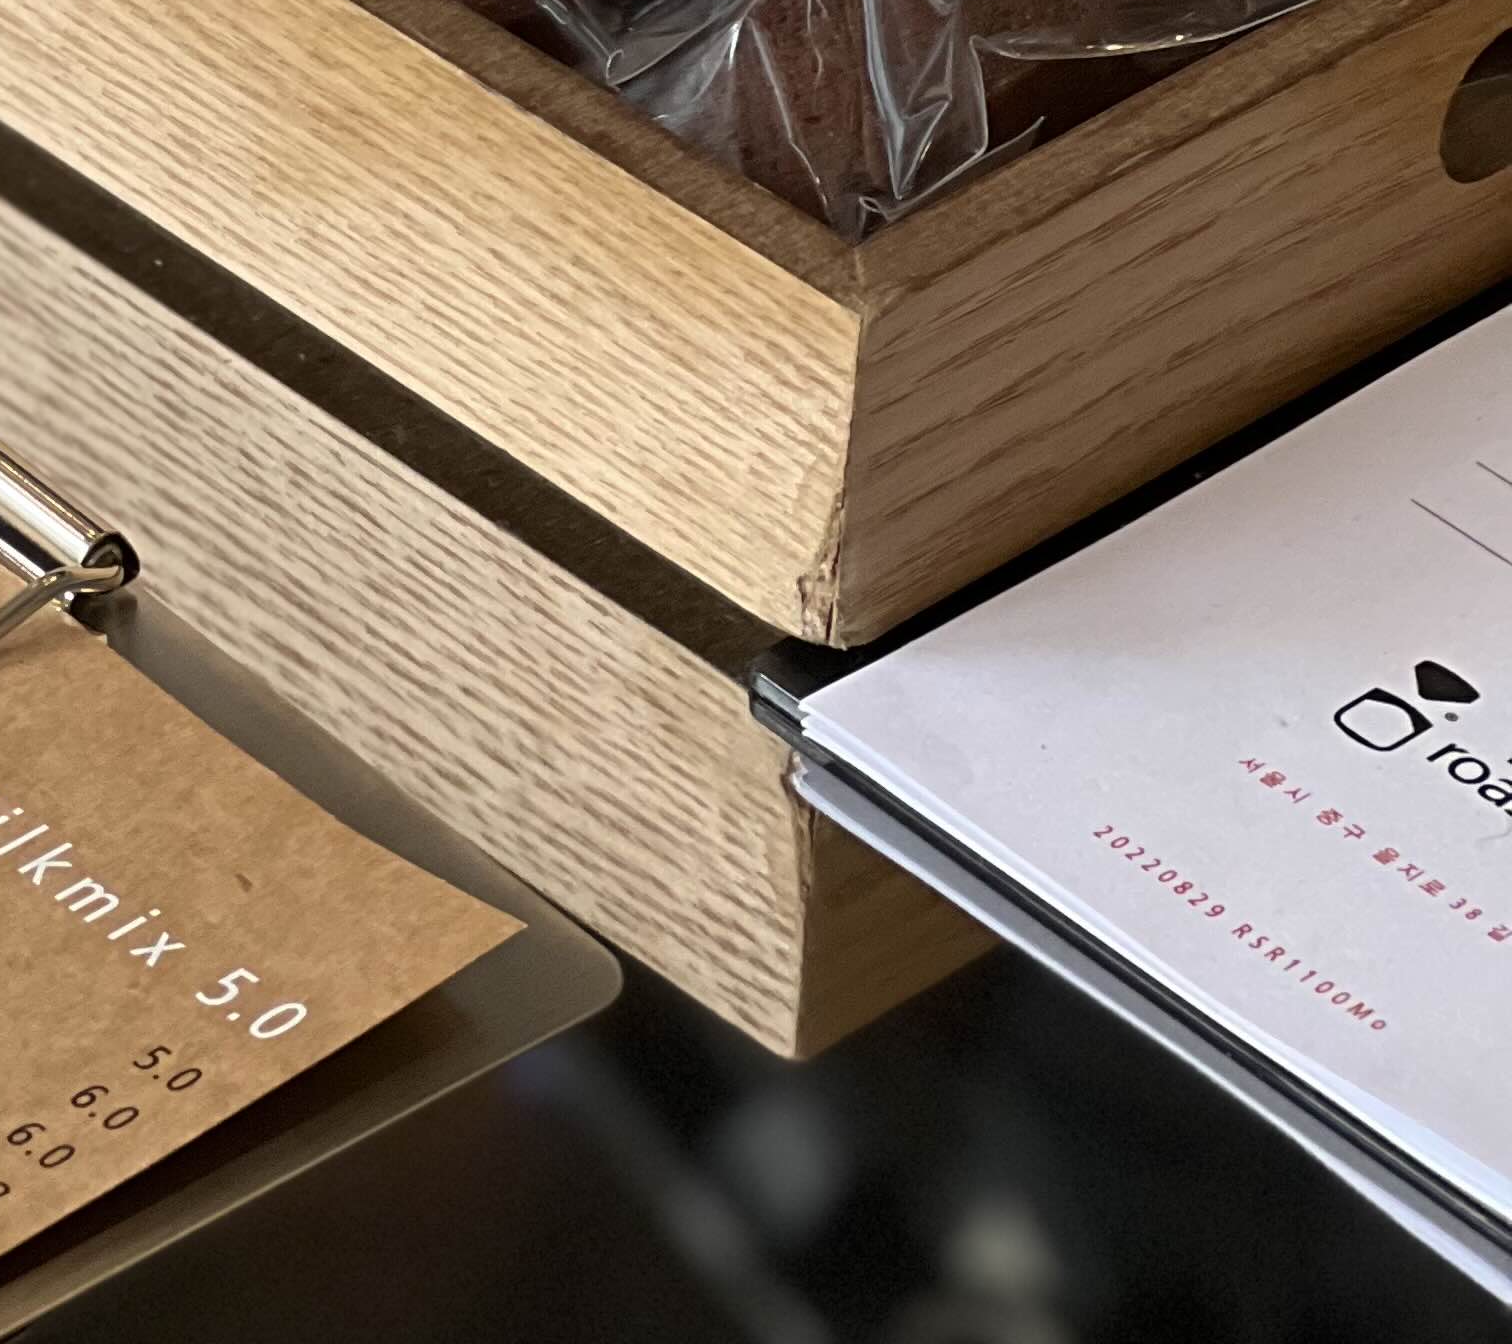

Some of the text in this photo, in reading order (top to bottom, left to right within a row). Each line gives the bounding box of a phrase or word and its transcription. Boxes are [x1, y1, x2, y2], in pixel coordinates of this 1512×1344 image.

[1239, 758, 1312, 803] 서울시
[1316, 807, 1366, 840] 중구
[1426, 743, 1512, 817] roa
[1092, 824, 1226, 918] 20220829
[195, 967, 308, 1040] 5.0
[132, 1044, 203, 1093] 5.0
[70, 1084, 140, 1131] 6.0
[6, 1122, 76, 1170] 6.0
